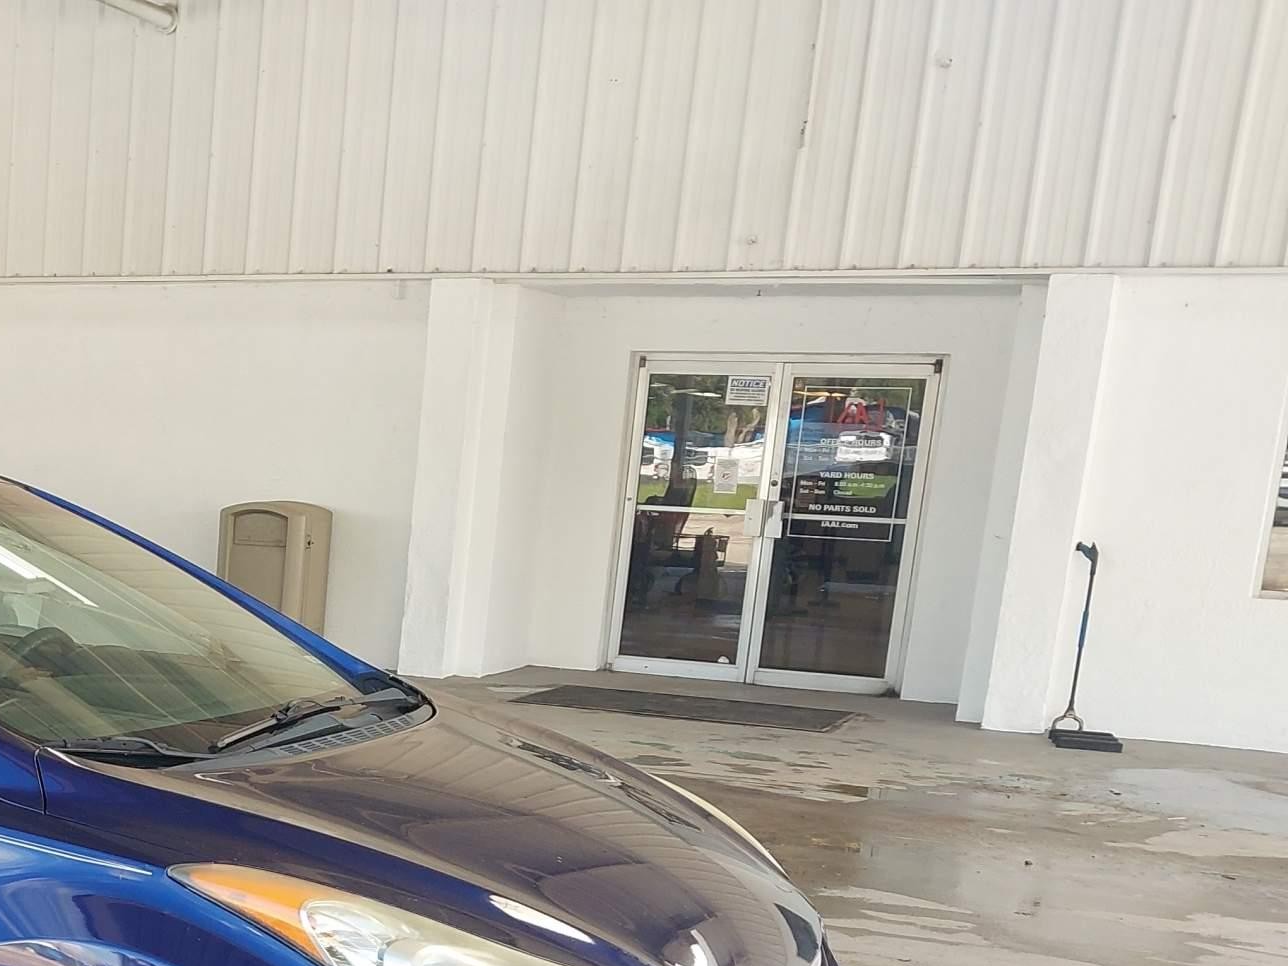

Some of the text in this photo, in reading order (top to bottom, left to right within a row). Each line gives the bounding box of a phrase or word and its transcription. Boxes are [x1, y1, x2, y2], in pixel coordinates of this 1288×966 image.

[731, 379, 768, 388] NOTICE
[820, 438, 882, 448] OFF HOURS
[819, 471, 875, 480] YARD HOURS
[808, 503, 877, 514] NO PARTS SOLD
